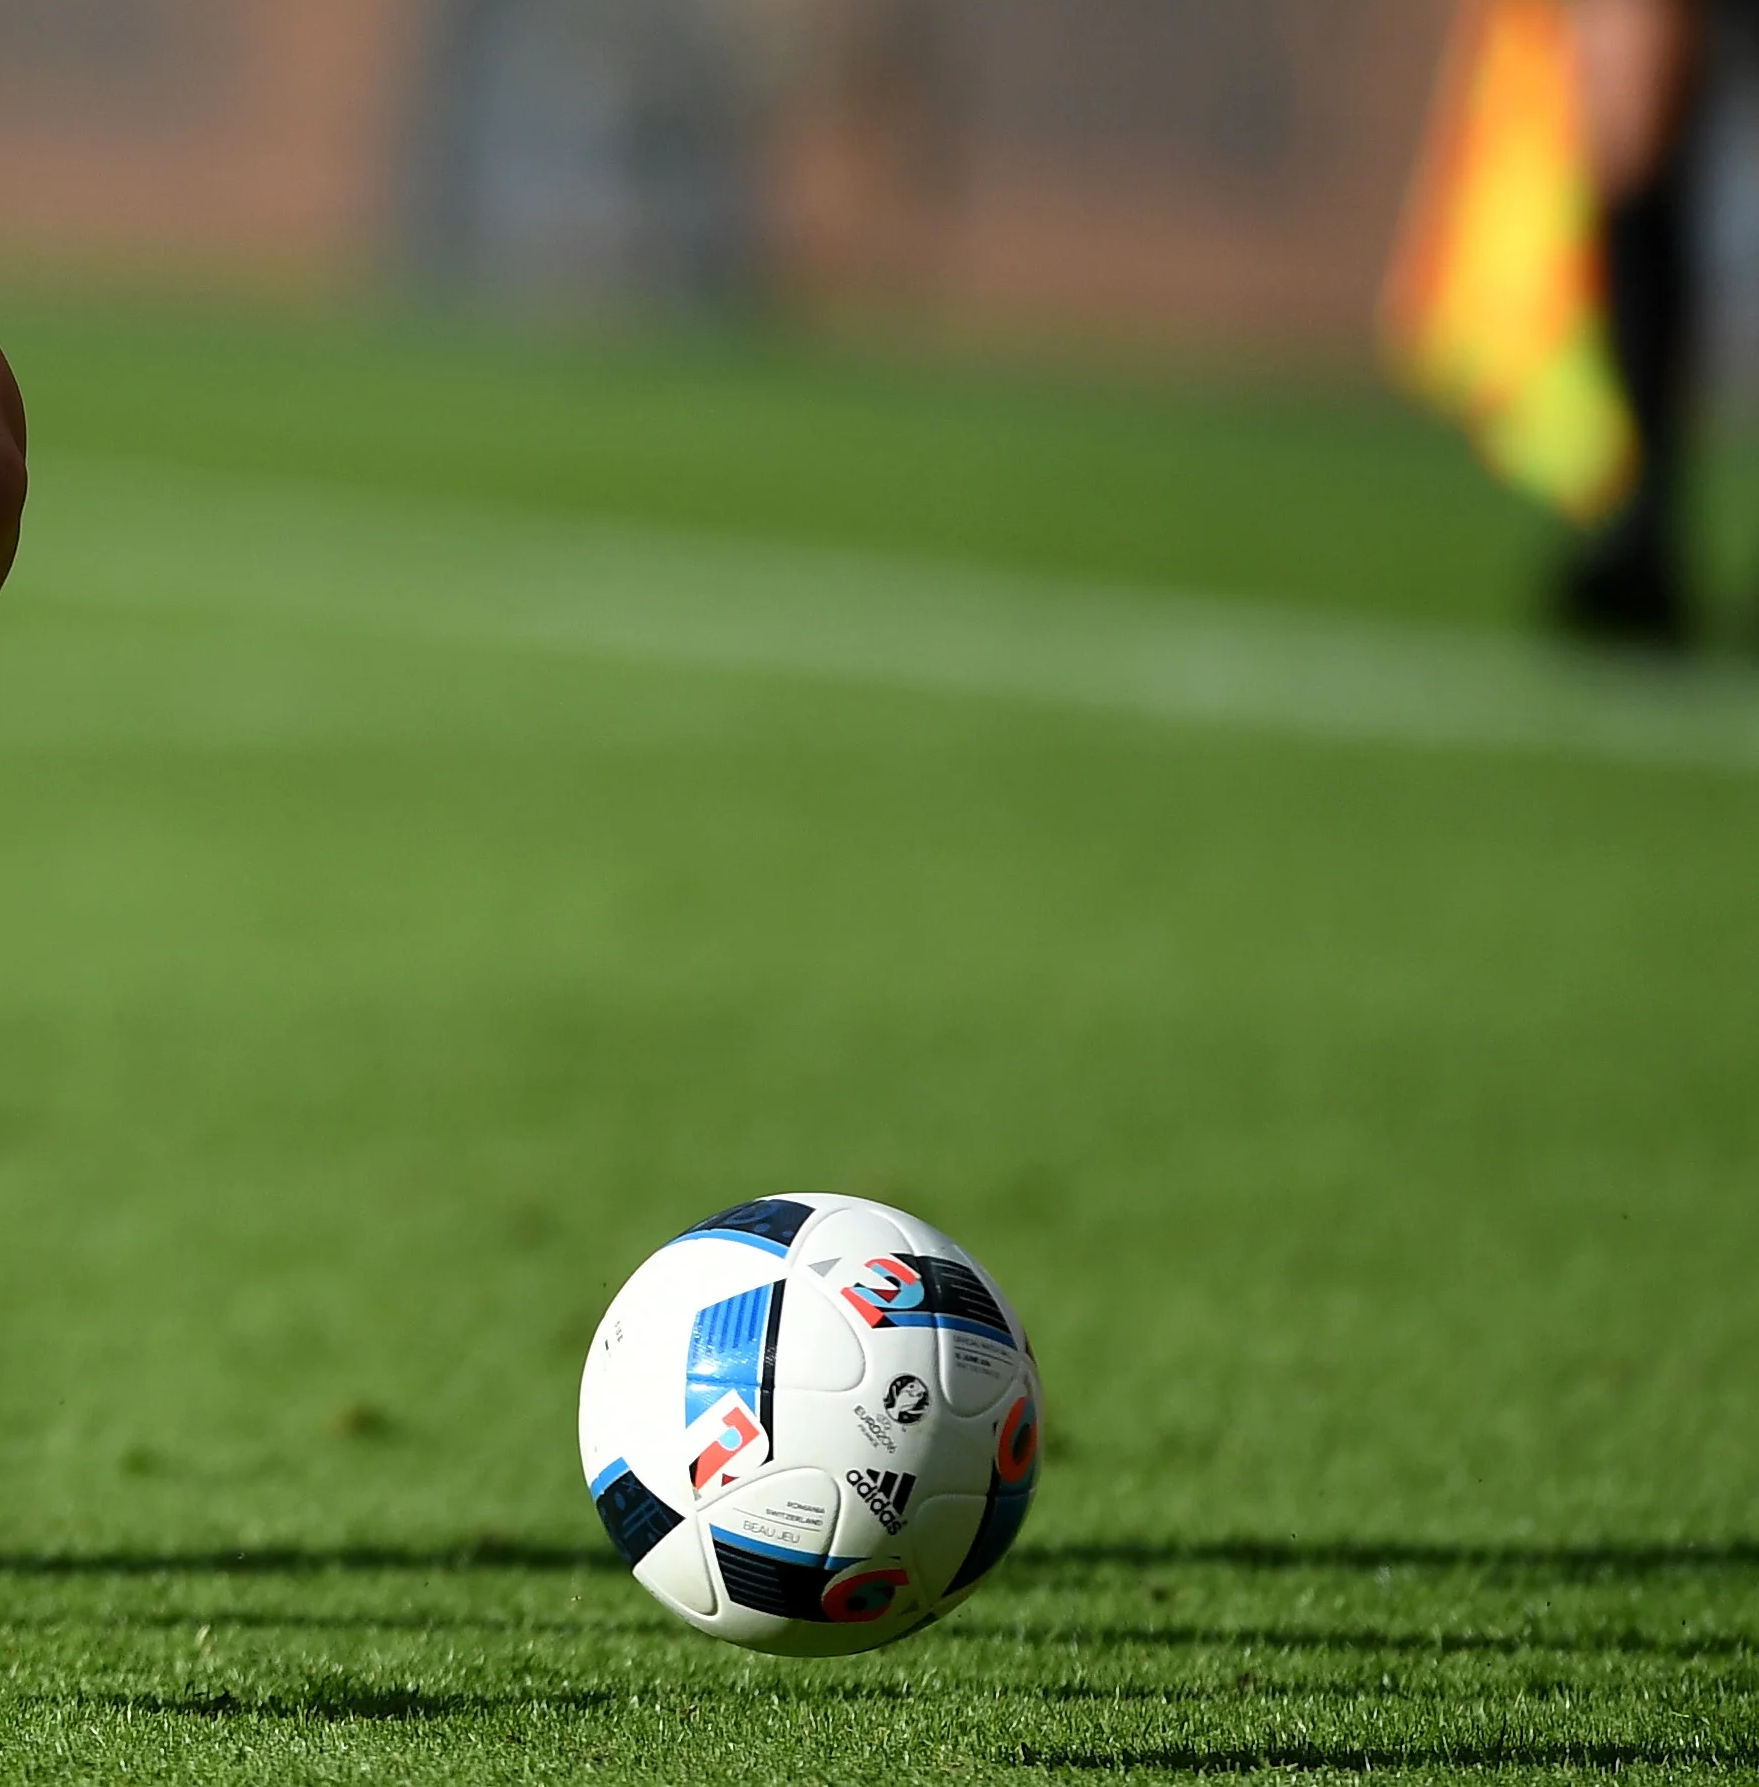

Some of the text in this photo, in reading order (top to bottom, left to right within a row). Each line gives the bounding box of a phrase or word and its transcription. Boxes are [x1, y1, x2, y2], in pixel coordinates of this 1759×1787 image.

[846, 1469, 903, 1536] adidas
[743, 1520, 801, 1544] BEAU JEU
